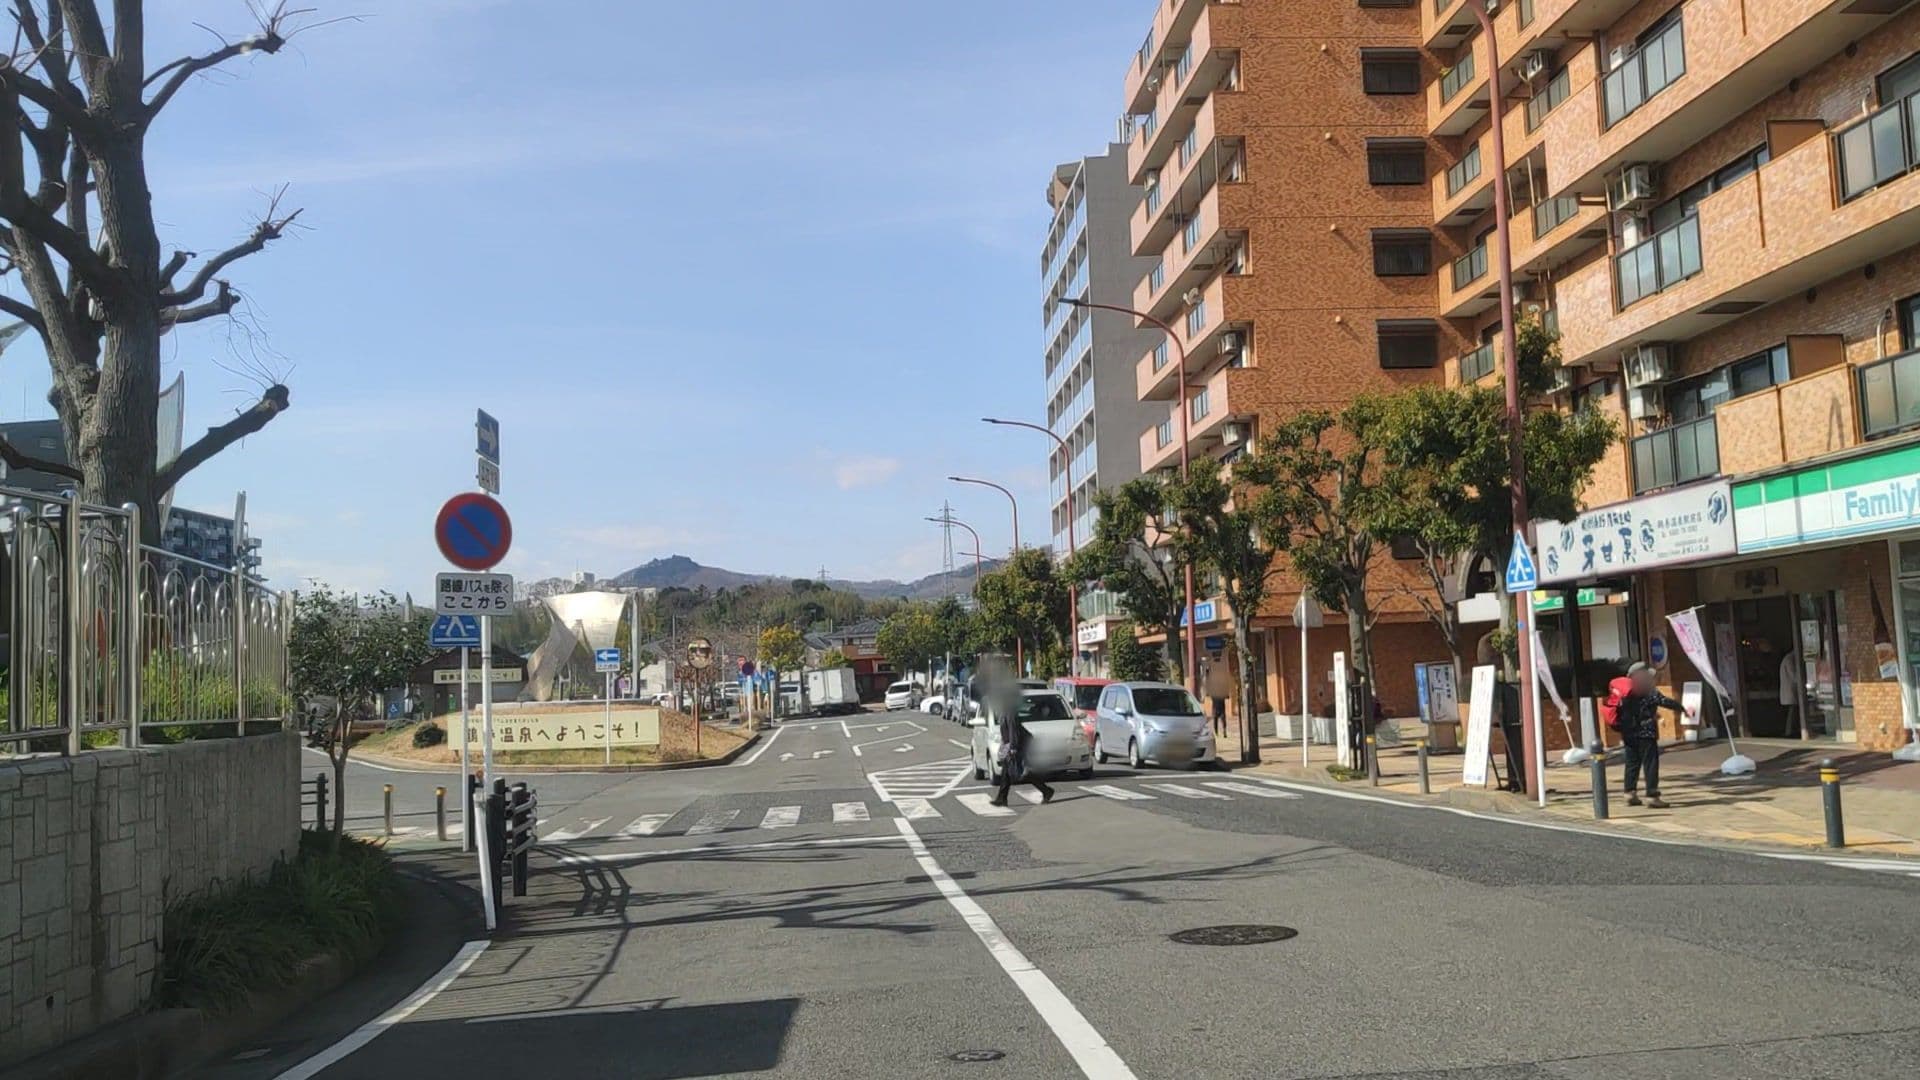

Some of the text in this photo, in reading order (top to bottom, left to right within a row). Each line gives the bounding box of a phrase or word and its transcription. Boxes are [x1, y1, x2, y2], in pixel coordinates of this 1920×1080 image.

[1845, 478, 1920, 520] Family
[440, 578, 509, 593] 路線バスを除く
[444, 595, 507, 609] ここから
[467, 721, 640, 743] 鶴温泉へようこそ！
